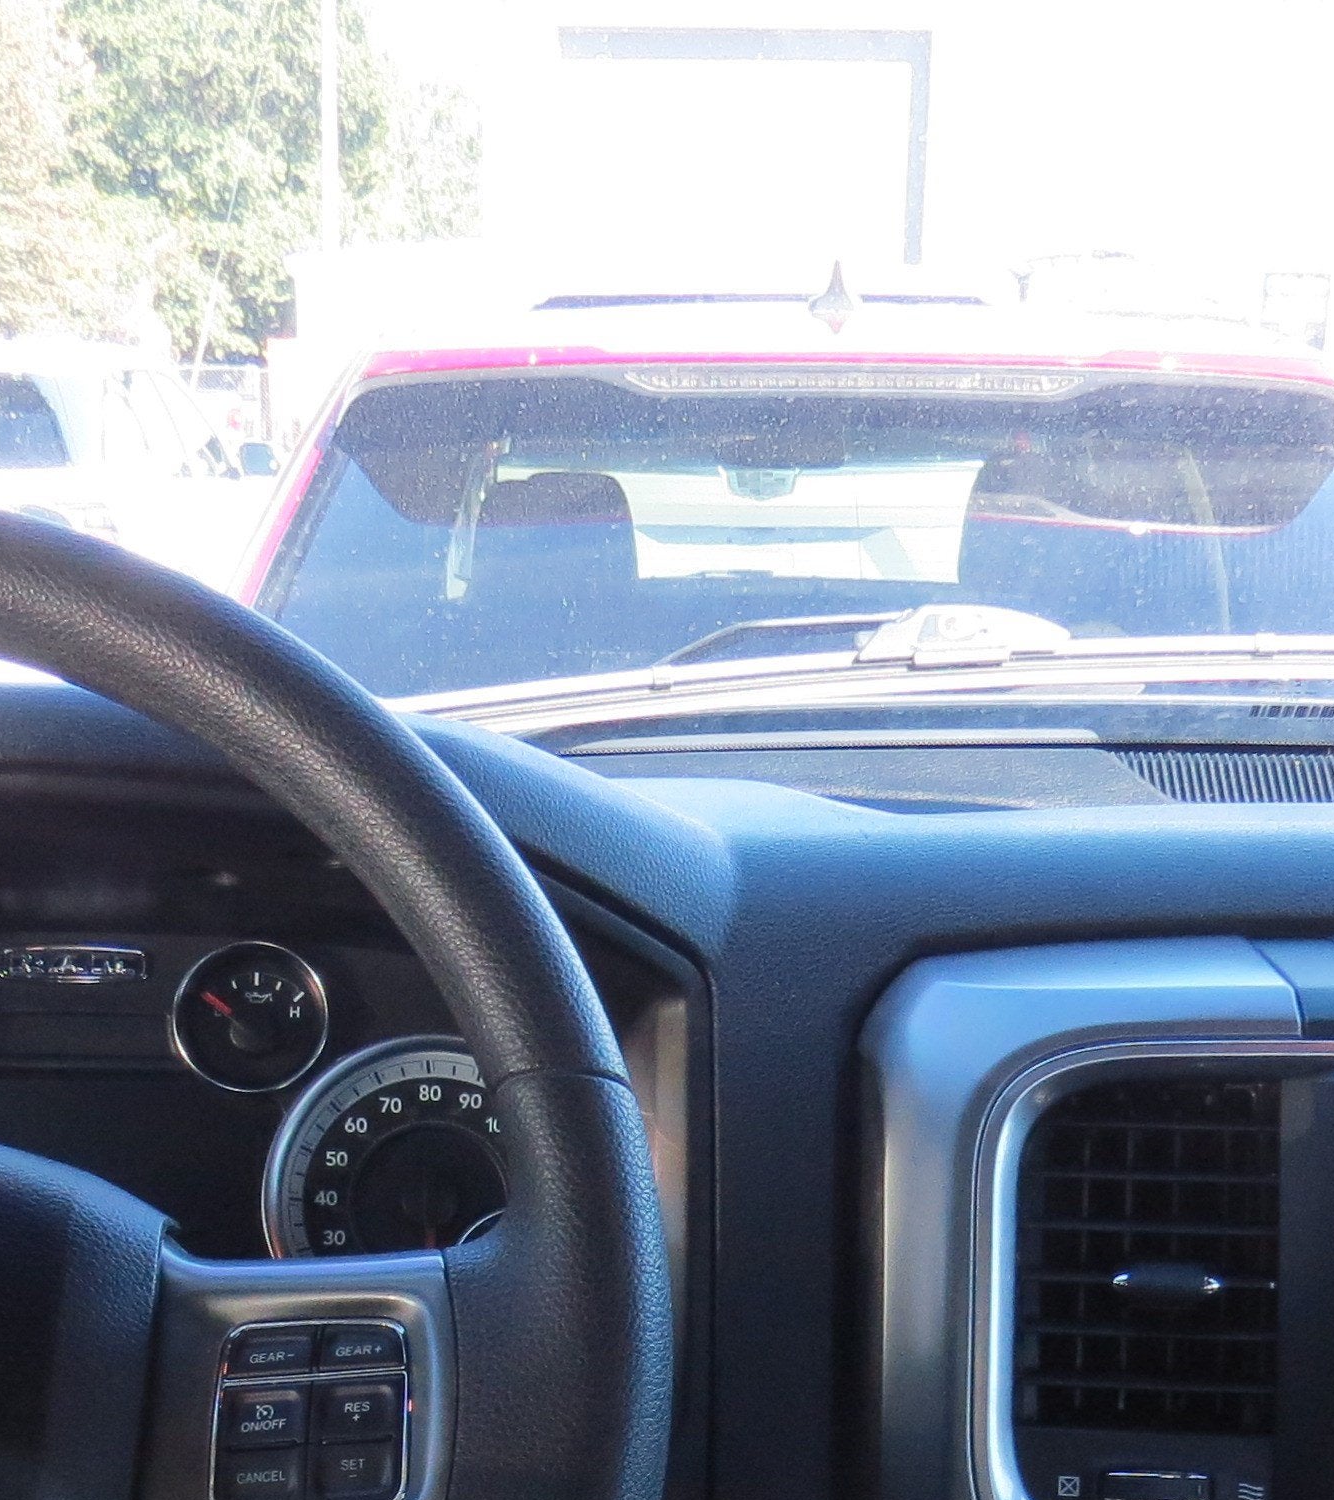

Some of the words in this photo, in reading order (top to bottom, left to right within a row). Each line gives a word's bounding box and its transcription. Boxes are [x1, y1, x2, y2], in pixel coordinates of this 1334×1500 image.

[289, 1005, 301, 1019] H
[418, 1084, 442, 1102] 80
[458, 1092, 483, 1110] 90
[378, 1096, 403, 1114] 70
[344, 1116, 368, 1134] 60
[325, 1151, 348, 1168] 50
[314, 1190, 339, 1207] 40
[323, 1229, 346, 1246] 30
[344, 1401, 371, 1414] RES
[240, 1418, 288, 1433] ON/OFF
[340, 1458, 366, 1471] SET
[236, 1470, 286, 1485] CANCEL
